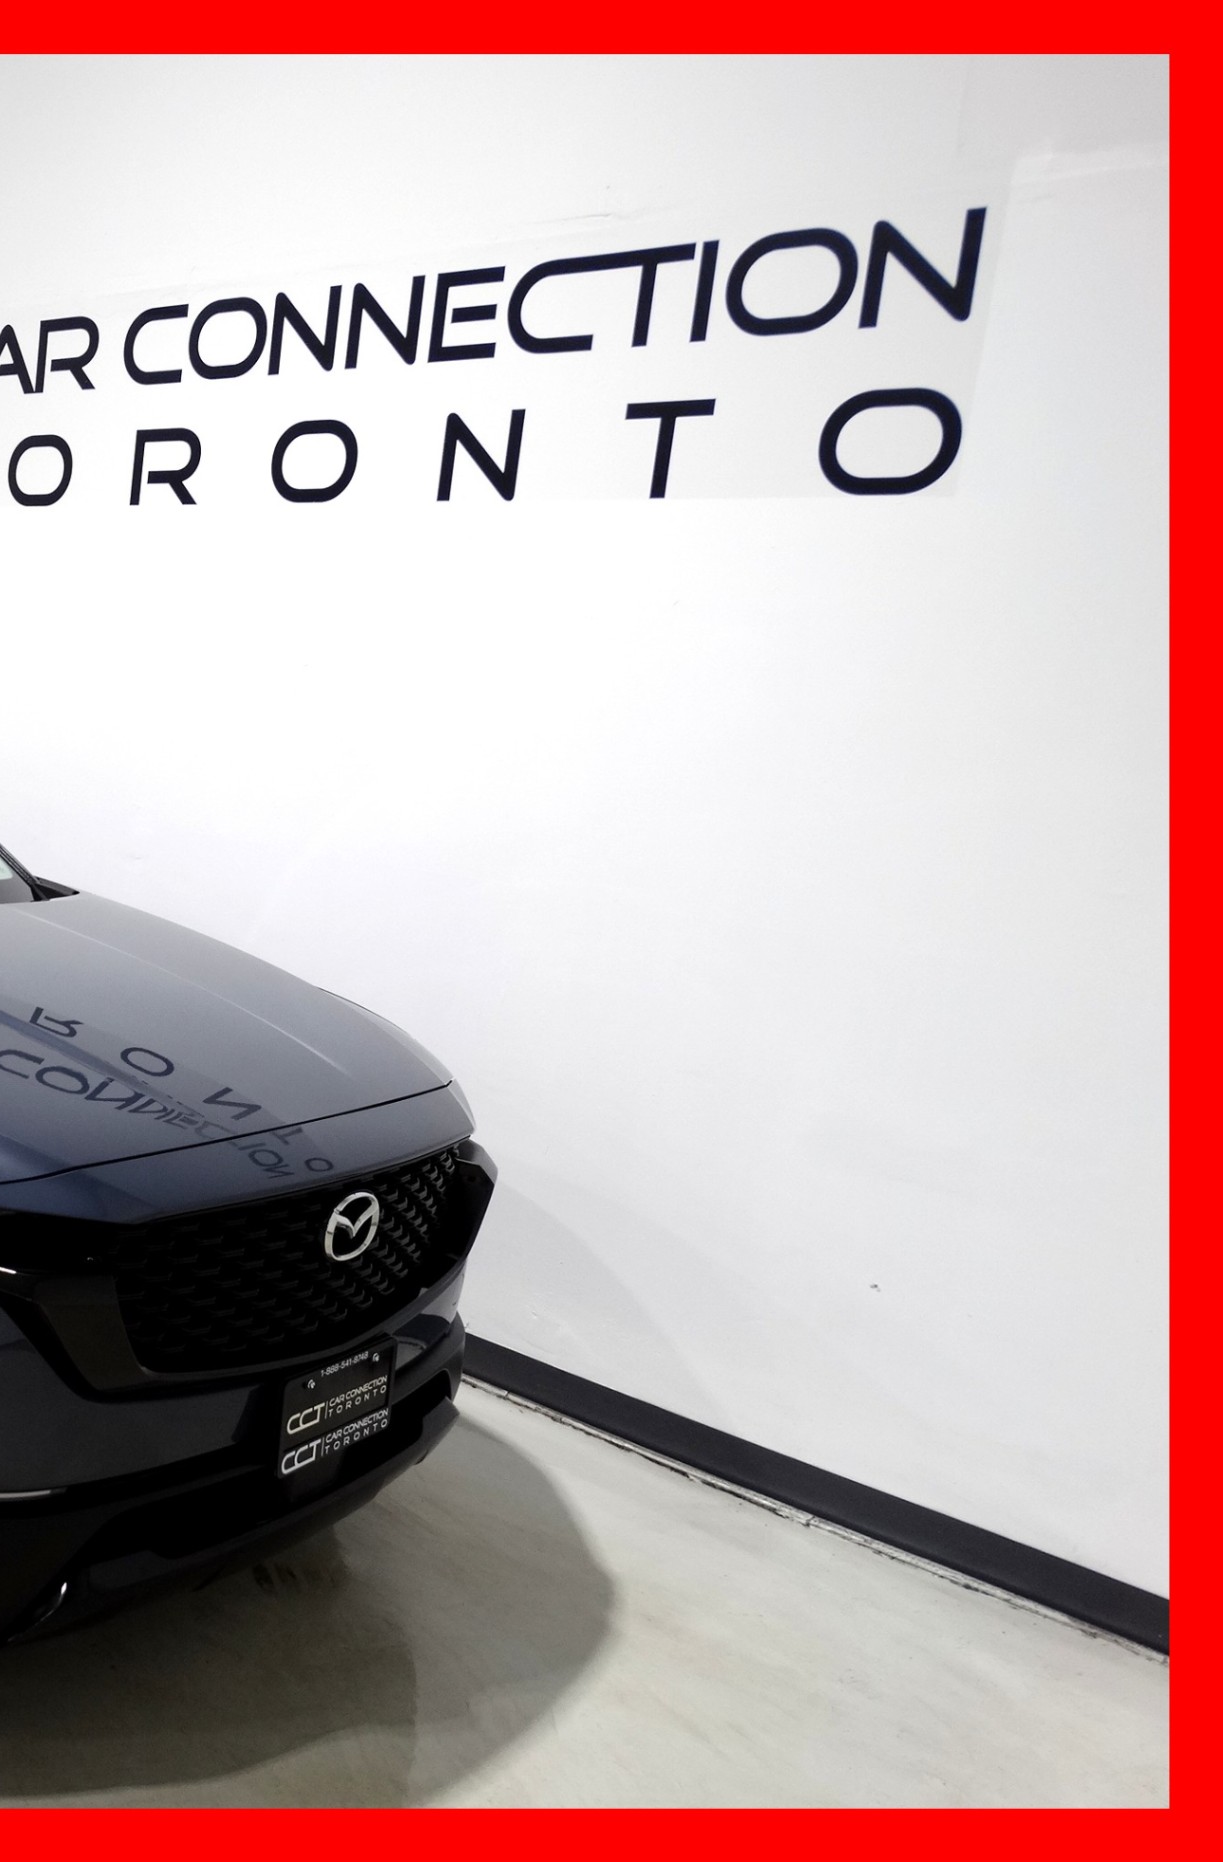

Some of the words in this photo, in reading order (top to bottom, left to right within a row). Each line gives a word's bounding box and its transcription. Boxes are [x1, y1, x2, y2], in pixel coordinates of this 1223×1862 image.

[123, 207, 987, 386] CONNECTION
[328, 1385, 387, 1418] TORONTO
[329, 1394, 345, 1407] CAR
[345, 1375, 388, 1400] CONNECTION
[286, 1402, 325, 1435] CCT
[325, 1430, 343, 1443] CAR
[343, 1408, 389, 1435] CONNECTION
[324, 1419, 388, 1455] TORONTO
[281, 1438, 322, 1475] CCT
